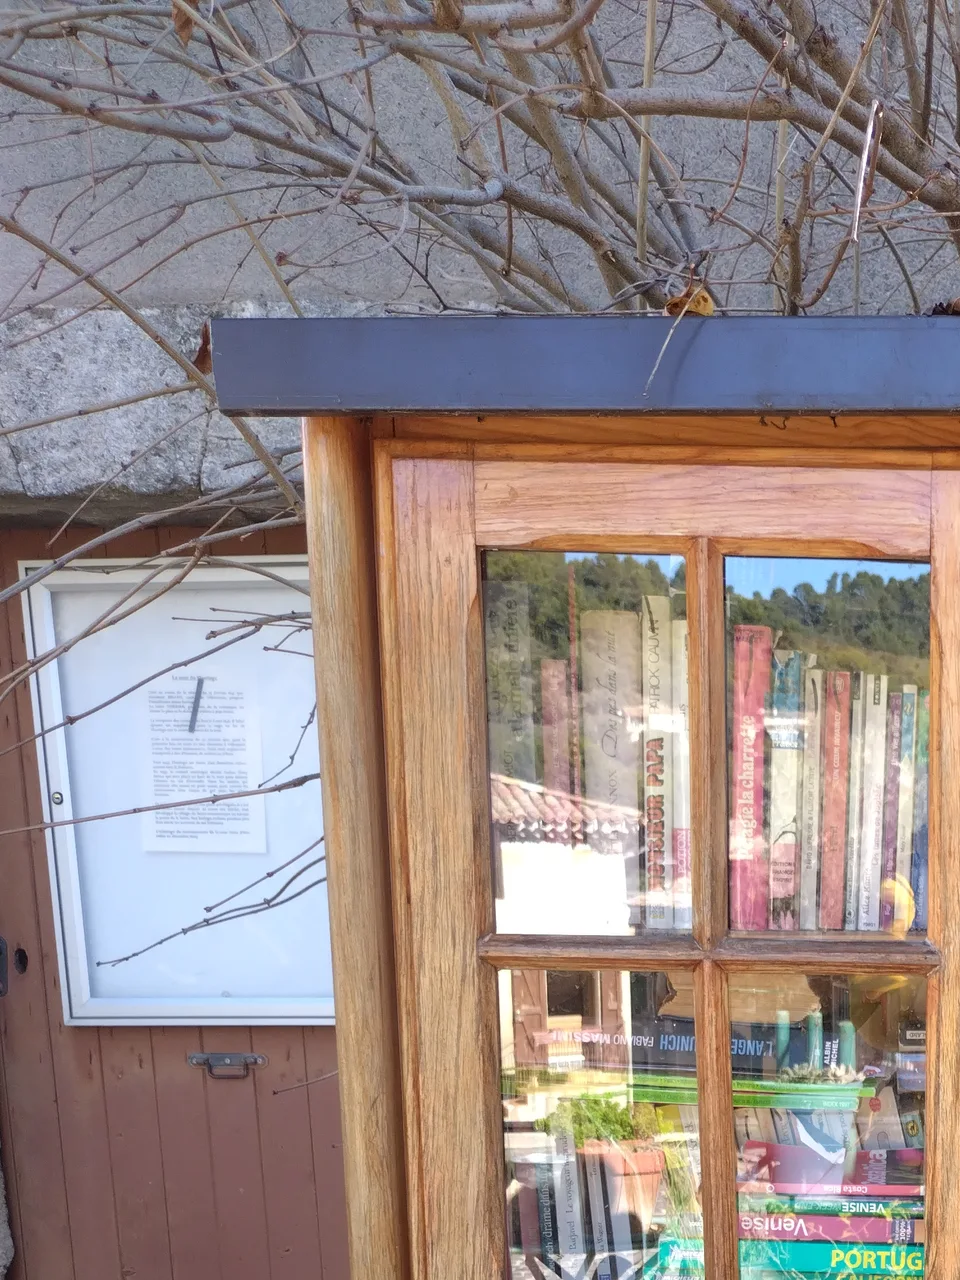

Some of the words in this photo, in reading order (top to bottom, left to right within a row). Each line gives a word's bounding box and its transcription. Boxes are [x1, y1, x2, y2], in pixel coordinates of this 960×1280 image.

[596, 655, 616, 667] la
[596, 670, 617, 696] dans
[648, 668, 660, 712] PATRICK
[646, 737, 665, 787] PAPA
[738, 715, 756, 789] charrette
[833, 768, 840, 780] UN
[737, 791, 754, 806] la
[646, 794, 666, 892] MONSIEUR
[677, 830, 687, 873] POTION
[862, 895, 871, 916] Alice
[613, 1034, 655, 1047] FABIANO
[660, 1034, 696, 1052] UNICH
[732, 1039, 774, 1058] L'ANGE
[824, 1041, 832, 1065] ALBIN
[541, 1184, 551, 1206] dans
[563, 1167, 574, 1202] voyageur
[823, 1185, 842, 1194] Rica
[843, 1185, 868, 1194] Costa
[565, 1204, 574, 1214] Le
[841, 1202, 885, 1213] VENISE
[543, 1207, 553, 1239] drame
[741, 1217, 808, 1237] Venise
[566, 1220, 578, 1250] Barjavel
[830, 1249, 922, 1271] PORTUG
